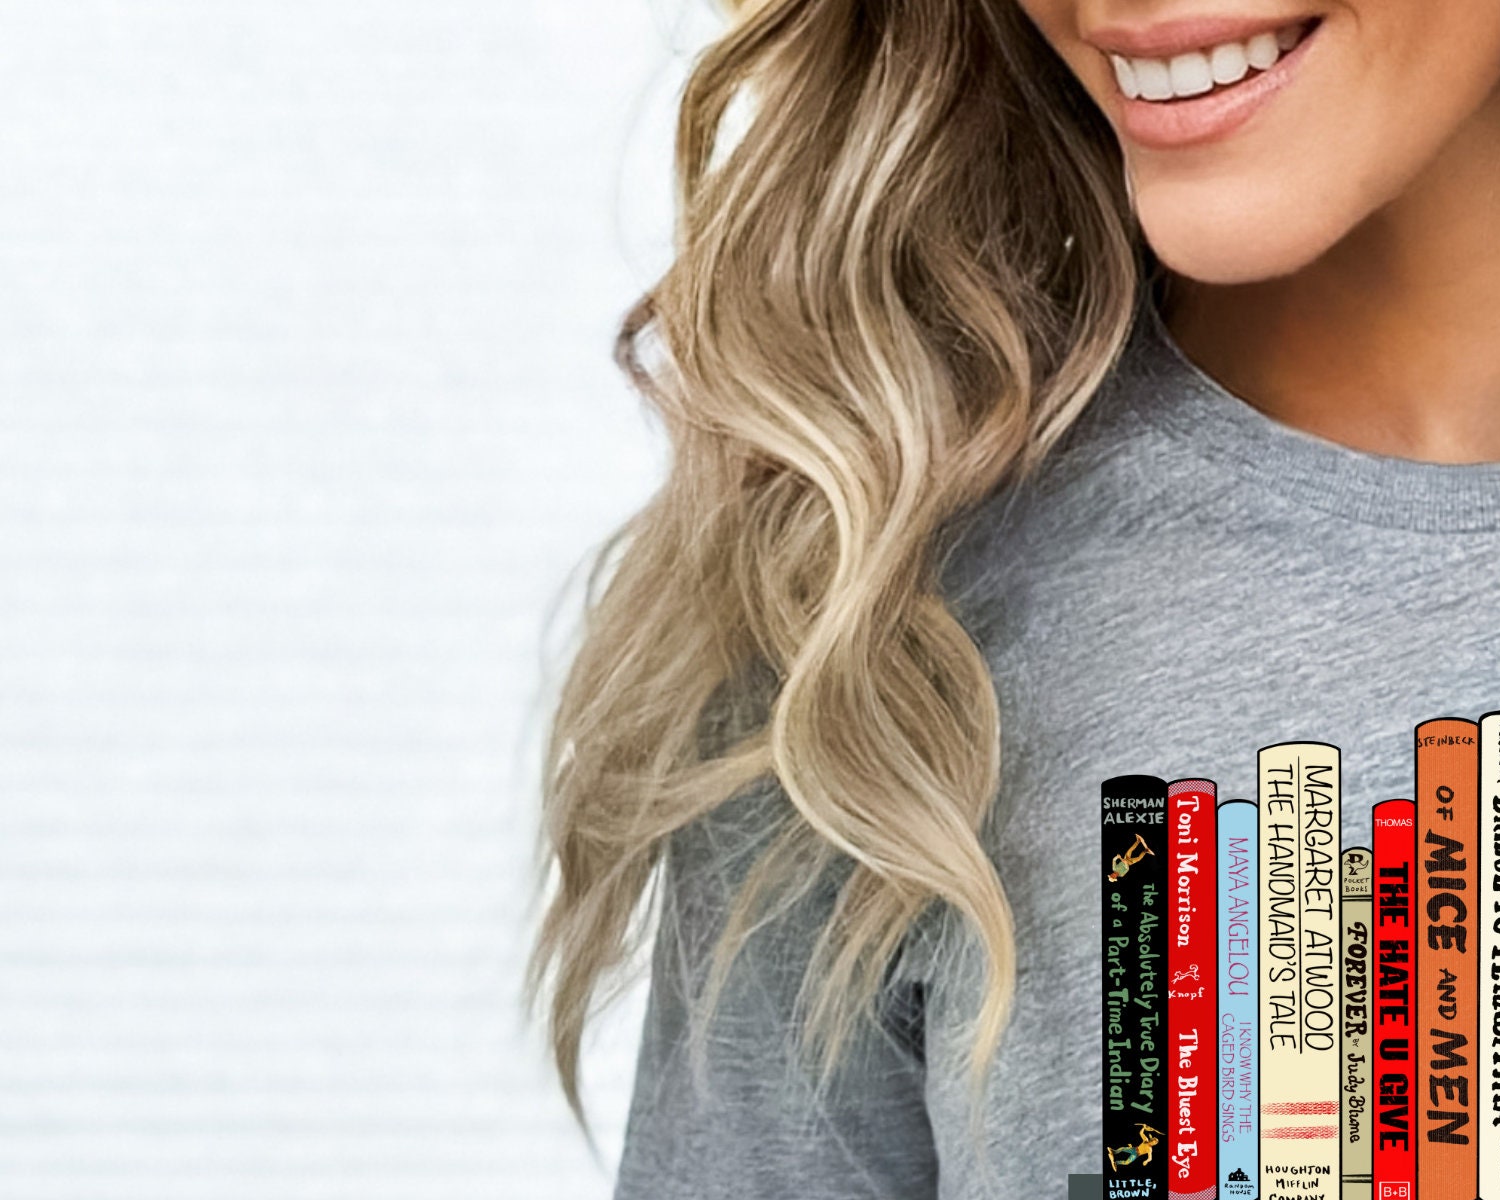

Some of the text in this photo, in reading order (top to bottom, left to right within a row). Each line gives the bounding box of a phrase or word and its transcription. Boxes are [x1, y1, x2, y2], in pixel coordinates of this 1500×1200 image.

[1417, 735, 1476, 748] STEINBECK
[1103, 796, 1165, 810] SHERMAN
[1103, 811, 1165, 825] ALEXIE
[1375, 818, 1413, 828] THOMAS
[1177, 796, 1199, 947] Toni Morrison
[1228, 838, 1249, 995] MAYA ANGELOU
[1268, 764, 1296, 1050] THE HANDMAID'S TALE
[1304, 766, 1334, 1050] MARGARET ATWOOD
[1345, 922, 1367, 1038] FOREVER
[1425, 786, 1469, 1145] OF MICE AND MEN
[1107, 893, 1133, 1110] of a Part-Time Indian
[1129, 883, 1160, 1113] The Absolutely True Diary
[1168, 987, 1204, 1000] Knopf
[1380, 862, 1408, 1151] THE HATE U GIVE
[1238, 1028, 1252, 1070] KNOW
[1221, 1012, 1235, 1143] CAGED BIRD SINGS
[1239, 1071, 1252, 1102] WHY
[1344, 1053, 1365, 1092] Judy
[1172, 1029, 1198, 1178] The Bluest Eye
[1239, 1104, 1252, 1134] THE
[1349, 1096, 1365, 1143] Blume
[1109, 1179, 1157, 1190] LITTLE,
[1265, 1165, 1331, 1176] HOUGHTON
[1275, 1177, 1319, 1190] MIFFLIN
[1109, 1189, 1150, 1200] BROWN
